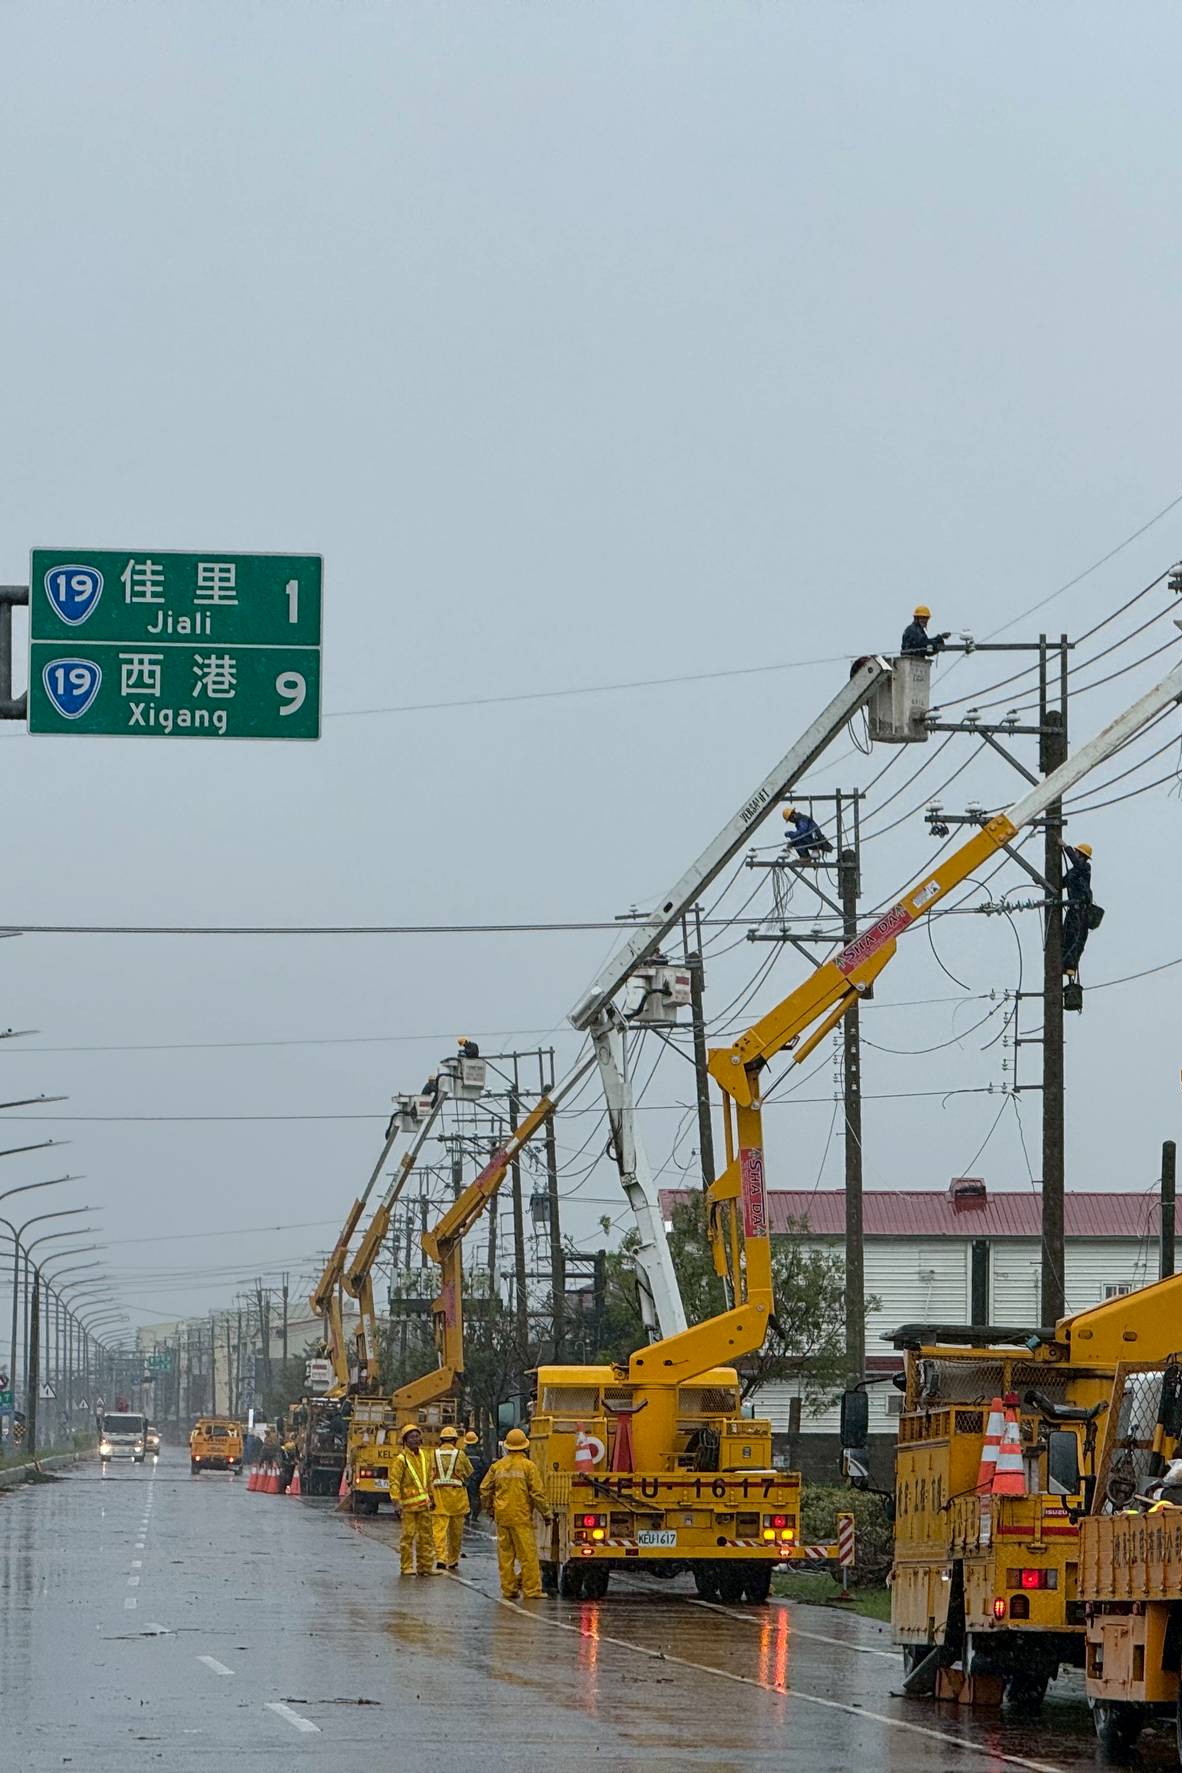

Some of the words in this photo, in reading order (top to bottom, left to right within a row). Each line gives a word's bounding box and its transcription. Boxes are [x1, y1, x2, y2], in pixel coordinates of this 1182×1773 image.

[57, 574, 93, 602] 19
[120, 559, 239, 606] 佳里
[285, 579, 299, 624] 1
[147, 610, 212, 635] Jiali
[55, 668, 92, 695] 19
[118, 653, 237, 698] 西港
[275, 671, 306, 716] 9
[128, 702, 228, 735] Xigang
[843, 934, 876, 961] SHA
[750, 1160, 762, 1194] SHA
[752, 1203, 763, 1225] DA
[593, 1477, 775, 1498] KEU-1617
[638, 1530, 676, 1545] KEU-1617
